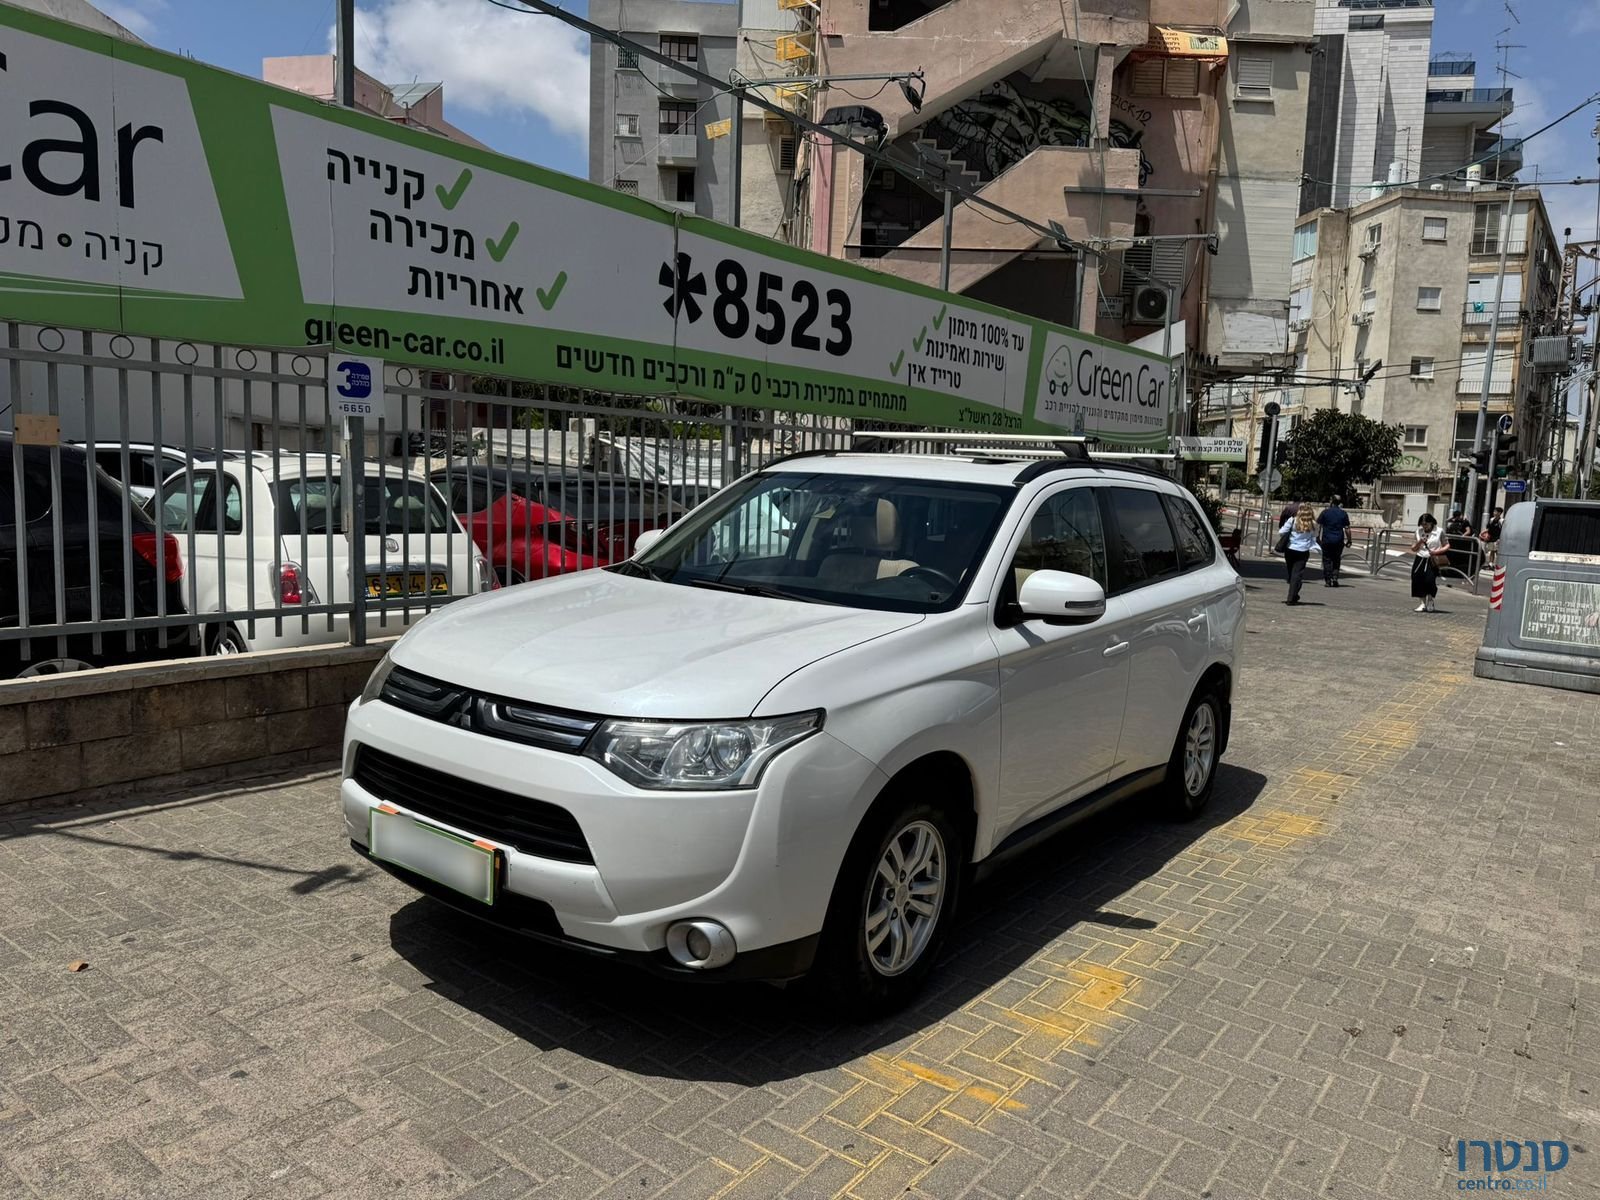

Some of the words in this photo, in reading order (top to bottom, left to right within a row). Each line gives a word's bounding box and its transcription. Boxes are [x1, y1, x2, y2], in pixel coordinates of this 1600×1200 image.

[326, 147, 425, 210] קנייה
[369, 208, 475, 261] מכירה
[84, 231, 164, 276] קניה
[407, 264, 525, 315] אחריות
[304, 316, 505, 365] green-car.co.il
[948, 316, 978, 340] מימון
[981, 322, 1009, 348] 100%
[925, 338, 970, 365] ואמינות
[1011, 332, 1025, 352] עד
[556, 344, 635, 378] חדשים
[642, 357, 706, 388] ורכבים
[972, 351, 1005, 372] שירות
[751, 372, 762, 396] 0
[907, 362, 927, 387] אין
[930, 367, 962, 389] טרייד
[1077, 349, 1133, 403] Green
[1136, 364, 1165, 409] Car
[766, 377, 800, 400] רכבי
[803, 382, 855, 406] במכירת
[858, 389, 907, 412] מתמחים
[991, 411, 1003, 427] 28
[1227, 439, 1244, 447] שלם
